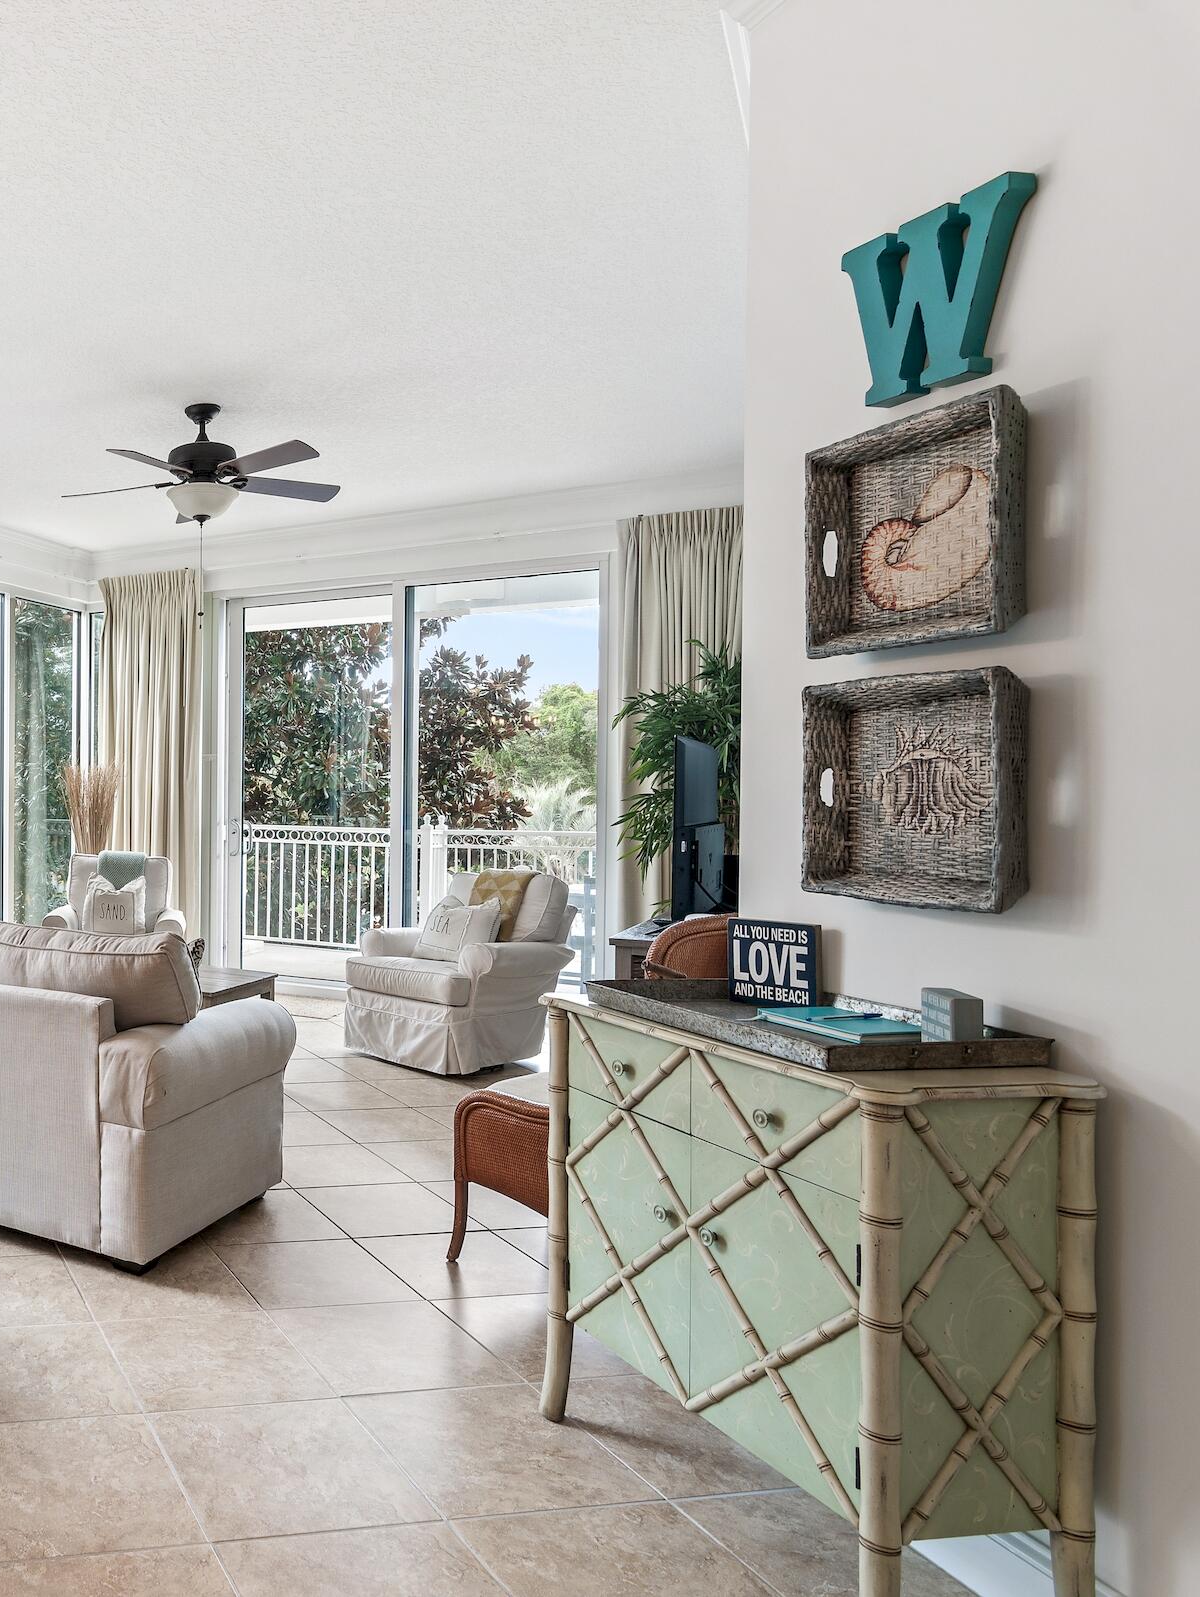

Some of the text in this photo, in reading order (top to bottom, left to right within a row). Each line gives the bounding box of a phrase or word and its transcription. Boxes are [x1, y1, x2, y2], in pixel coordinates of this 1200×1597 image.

[841, 171, 1038, 408] W
[733, 924, 808, 944] ALL YOU NEED IS
[733, 939, 809, 989] LOVE
[734, 982, 809, 1005] AND THE BEACH
